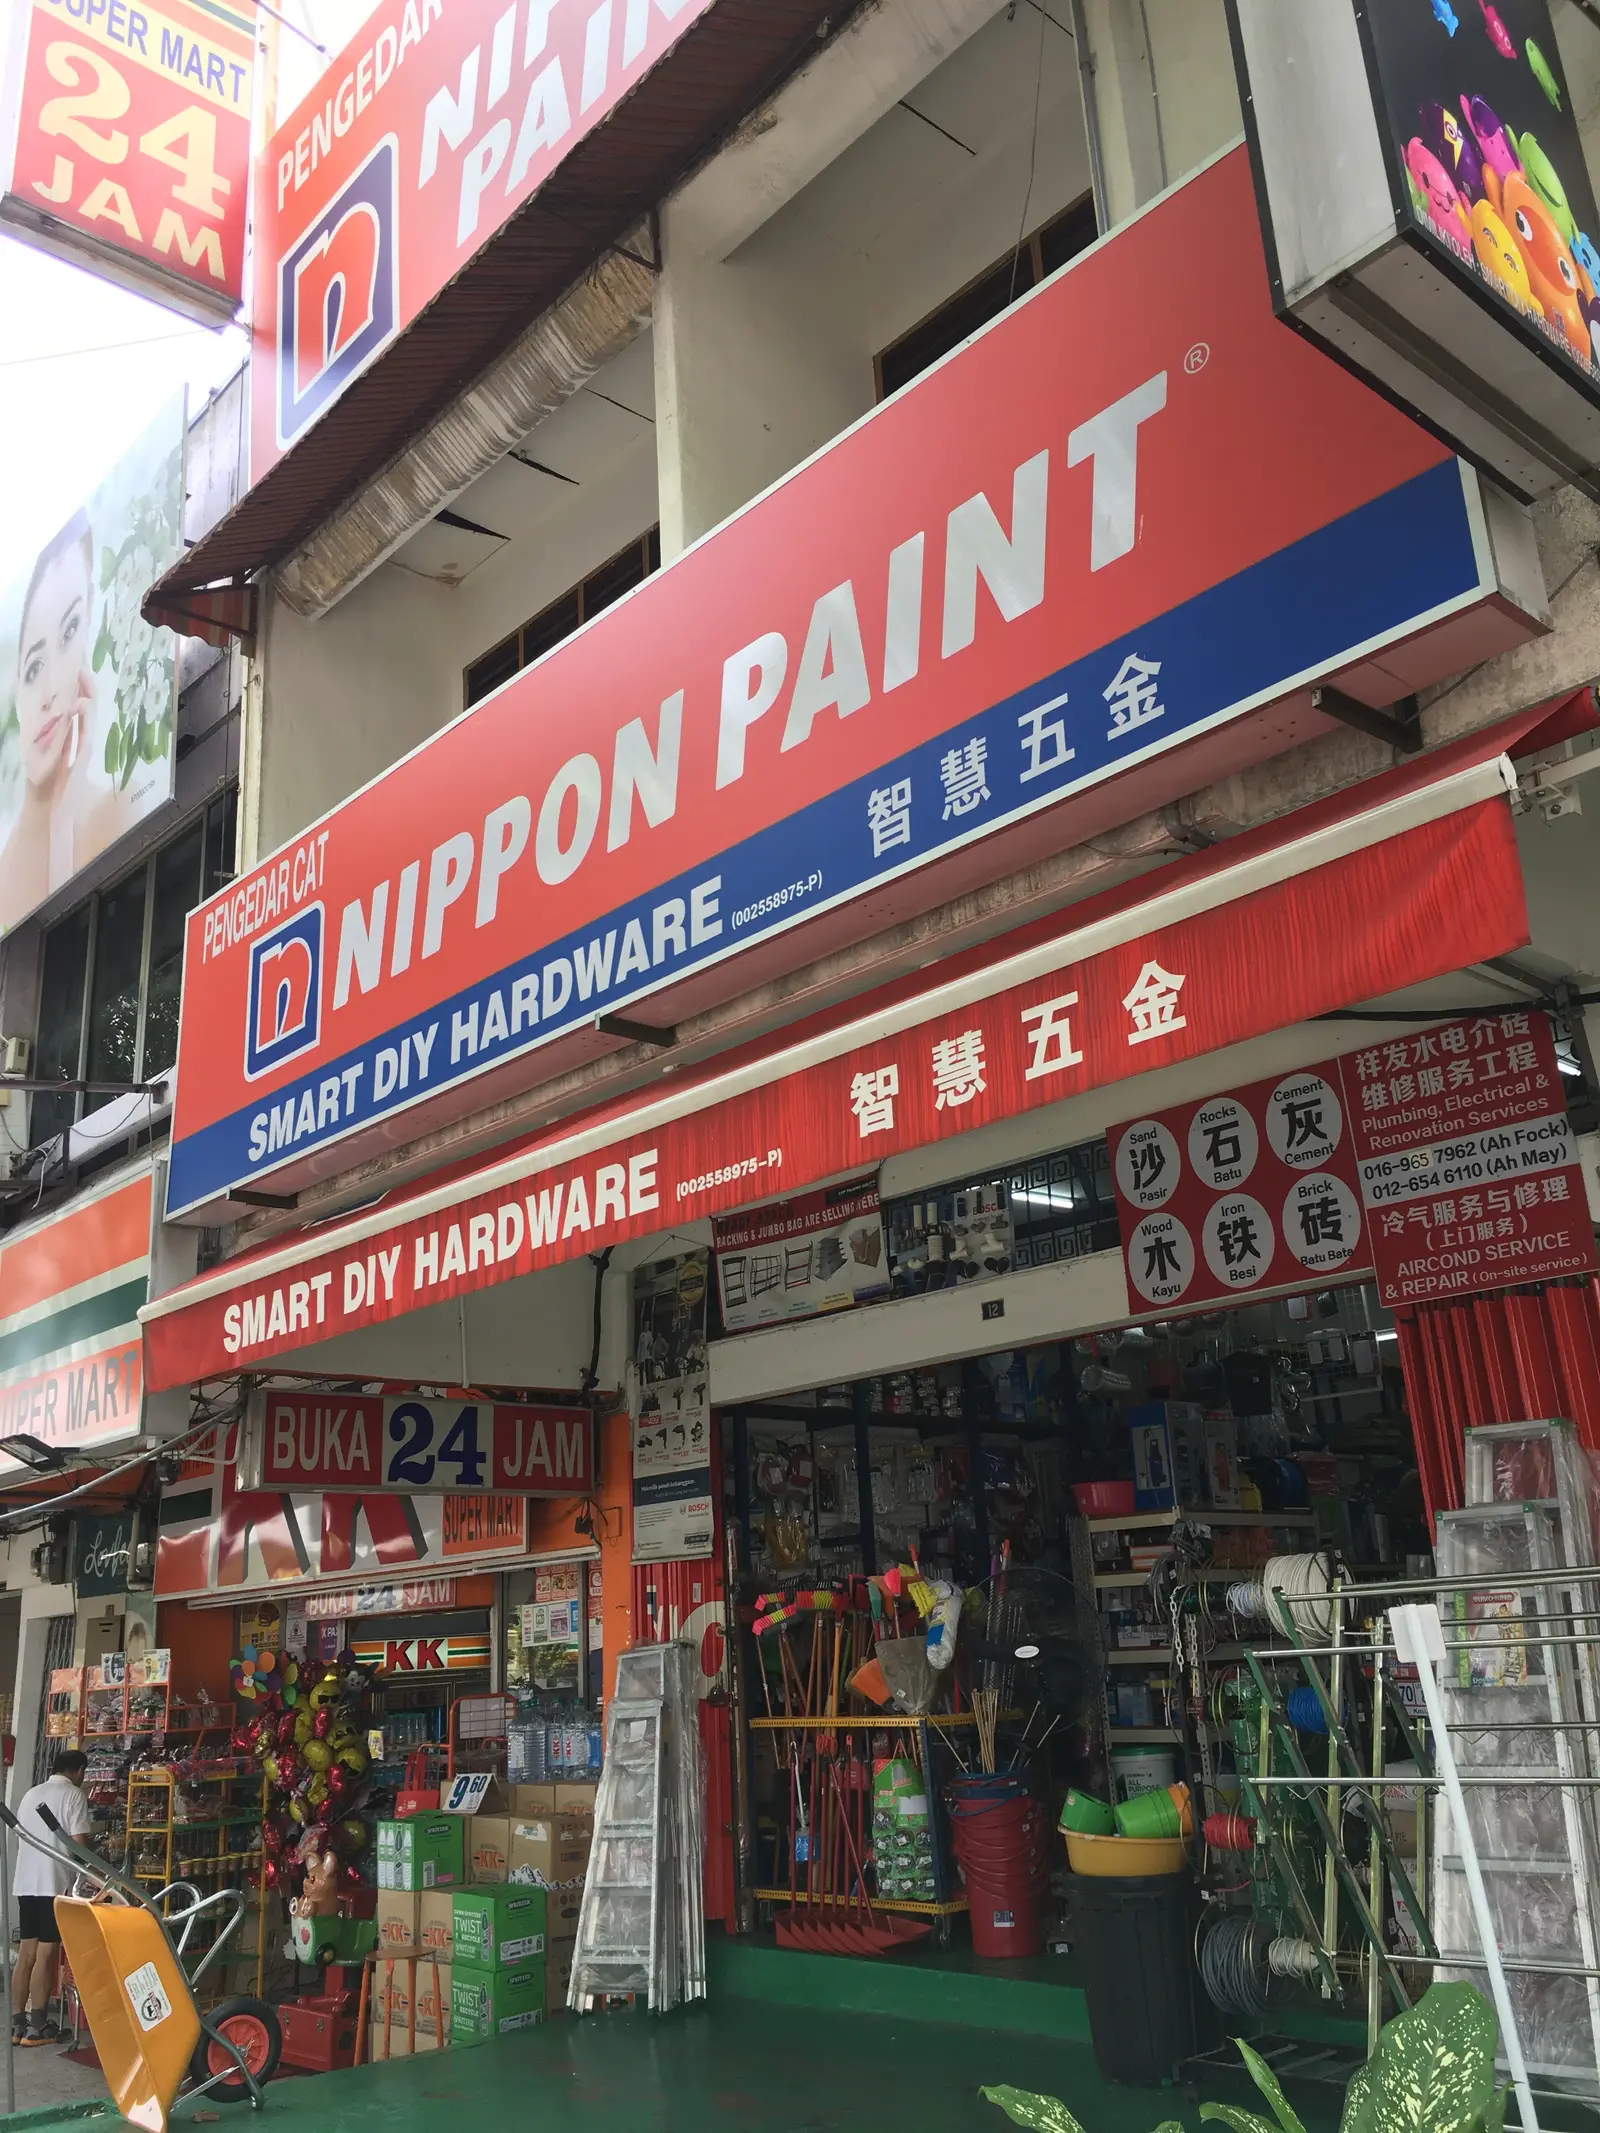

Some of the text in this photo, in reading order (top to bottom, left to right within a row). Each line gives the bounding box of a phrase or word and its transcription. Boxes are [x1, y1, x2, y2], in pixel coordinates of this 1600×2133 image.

[51, 0, 246, 103] UPER MART
[39, 40, 232, 221] 24
[31, 154, 226, 282] JAM
[332, 688, 685, 1011] NIPPON
[715, 369, 1168, 791] PAINT
[867, 651, 1167, 858] 智慧五金
[202, 830, 329, 964] PENGEDAR CAT
[248, 869, 824, 1162] SMART DIY HARDWARE (002558975-P)
[849, 959, 1187, 1138] 智慧五金
[1273, 1079, 1324, 1102] Cement
[1361, 1041, 1540, 1112] 维修服务工程
[1199, 1105, 1237, 1124] Rocks
[1281, 1098, 1328, 1149] 灰
[1361, 1073, 1550, 1133] Plumbing, Electrical &
[1370, 1097, 1549, 1150] Renovation Services
[1129, 1127, 1157, 1145] Sand
[1203, 1120, 1241, 1168] 石
[1284, 1142, 1335, 1165] Cement
[1364, 1118, 1568, 1180] 016-965 7962 (Ah Fock)
[1129, 1142, 1166, 1190] 沙
[1213, 1169, 1242, 1184] Batu
[1298, 1180, 1333, 1198] Brick
[1372, 1142, 1567, 1200] 012-654 6110 (Ah May)
[1139, 1187, 1168, 1203] Pasir
[1221, 1203, 1245, 1217] Iron
[1380, 1175, 1571, 1238] 冷气服务与修理
[716, 1230, 749, 1249] RACKING
[750, 1229, 757, 1241] &
[758, 1221, 785, 1240] JUMBO
[787, 1217, 803, 1232] BAG
[805, 1212, 821, 1227] ARE
[822, 1202, 856, 1223] SELLING
[1141, 1218, 1173, 1237] Wood
[1217, 1216, 1261, 1266] 铁
[1298, 1197, 1344, 1246] 砖
[223, 1147, 783, 1354] SMART DIY HARDWARE (002558975-P)
[1143, 1236, 1181, 1281] 木
[1229, 1266, 1257, 1281] Besi
[1300, 1247, 1354, 1266] Batu Bata
[1397, 1231, 1571, 1278] AIRCOND SERVICE
[1152, 1283, 1181, 1299] Kayu
[1385, 1285, 1399, 1299] &
[1402, 1270, 1469, 1297] REPAIR
[987, 1303, 999, 1317] 12
[66, 1349, 138, 1433] MART
[273, 1406, 370, 1471] BUKA
[388, 1402, 487, 1486] 24
[502, 1419, 584, 1479] JAM
[444, 1495, 520, 1544] SUPER MART
[309, 1577, 450, 1616] BUKA 24 JAM
[387, 1639, 445, 1671] KK
[453, 1916, 481, 1934] TWIST
[453, 1988, 480, 2009] TWIST
